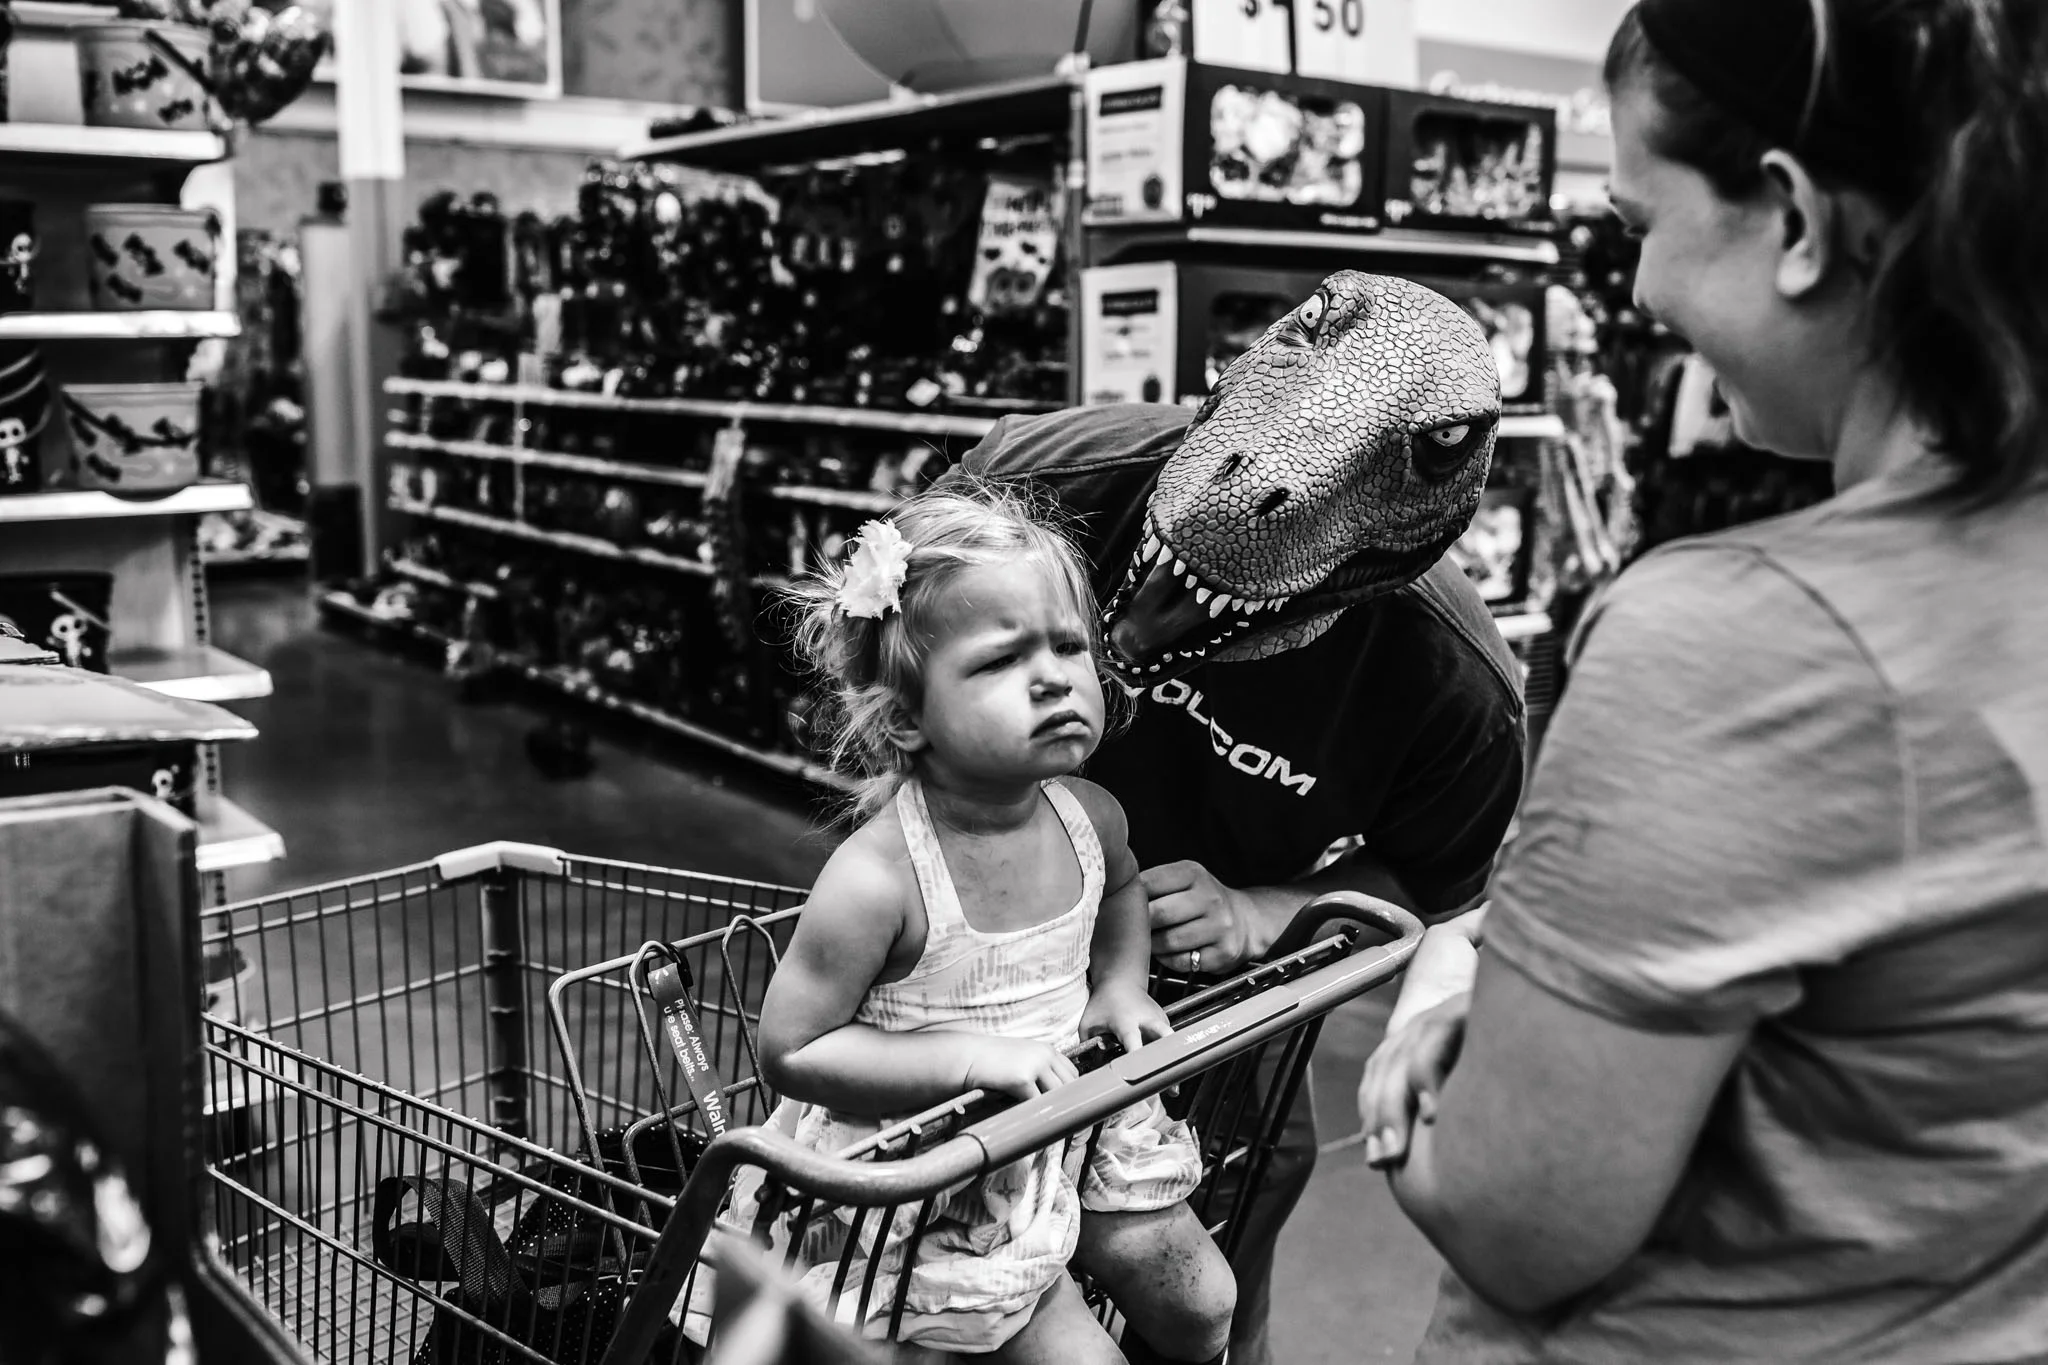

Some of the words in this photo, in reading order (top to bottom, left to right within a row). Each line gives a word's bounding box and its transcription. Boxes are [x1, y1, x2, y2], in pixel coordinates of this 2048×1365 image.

[663, 1005, 676, 1024] ue
[670, 1024, 687, 1048] seat
[688, 1036, 710, 1072] Always
[703, 1089, 727, 1140] Walm
